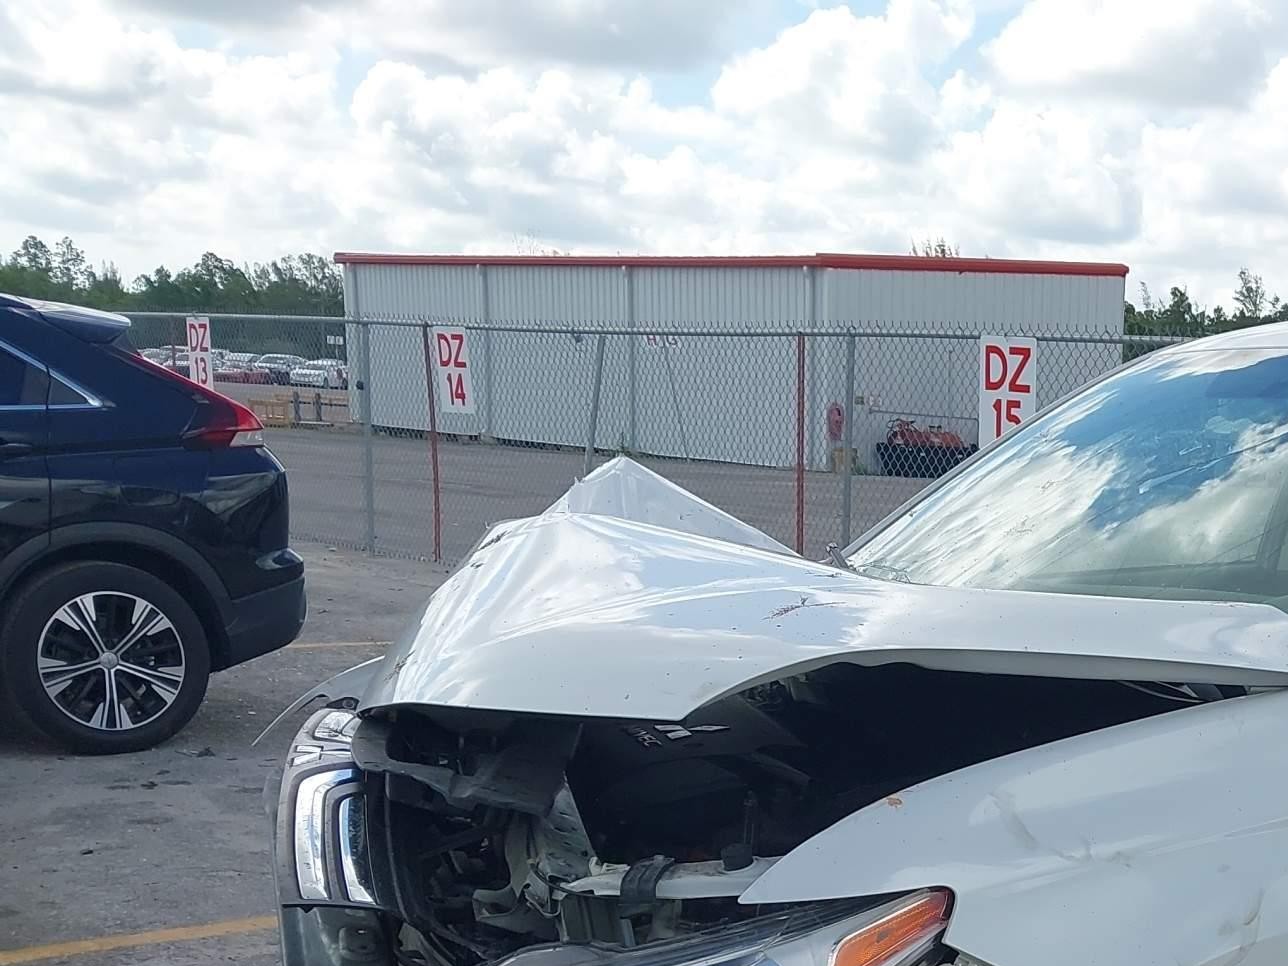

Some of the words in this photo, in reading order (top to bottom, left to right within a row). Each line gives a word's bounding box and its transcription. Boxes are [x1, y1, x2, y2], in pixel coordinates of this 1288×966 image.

[188, 323, 209, 352] DZ
[436, 333, 467, 369] DZ
[193, 357, 208, 385] 13
[984, 344, 1032, 394] DZ
[446, 373, 467, 406] 14
[992, 398, 1022, 437] 15
